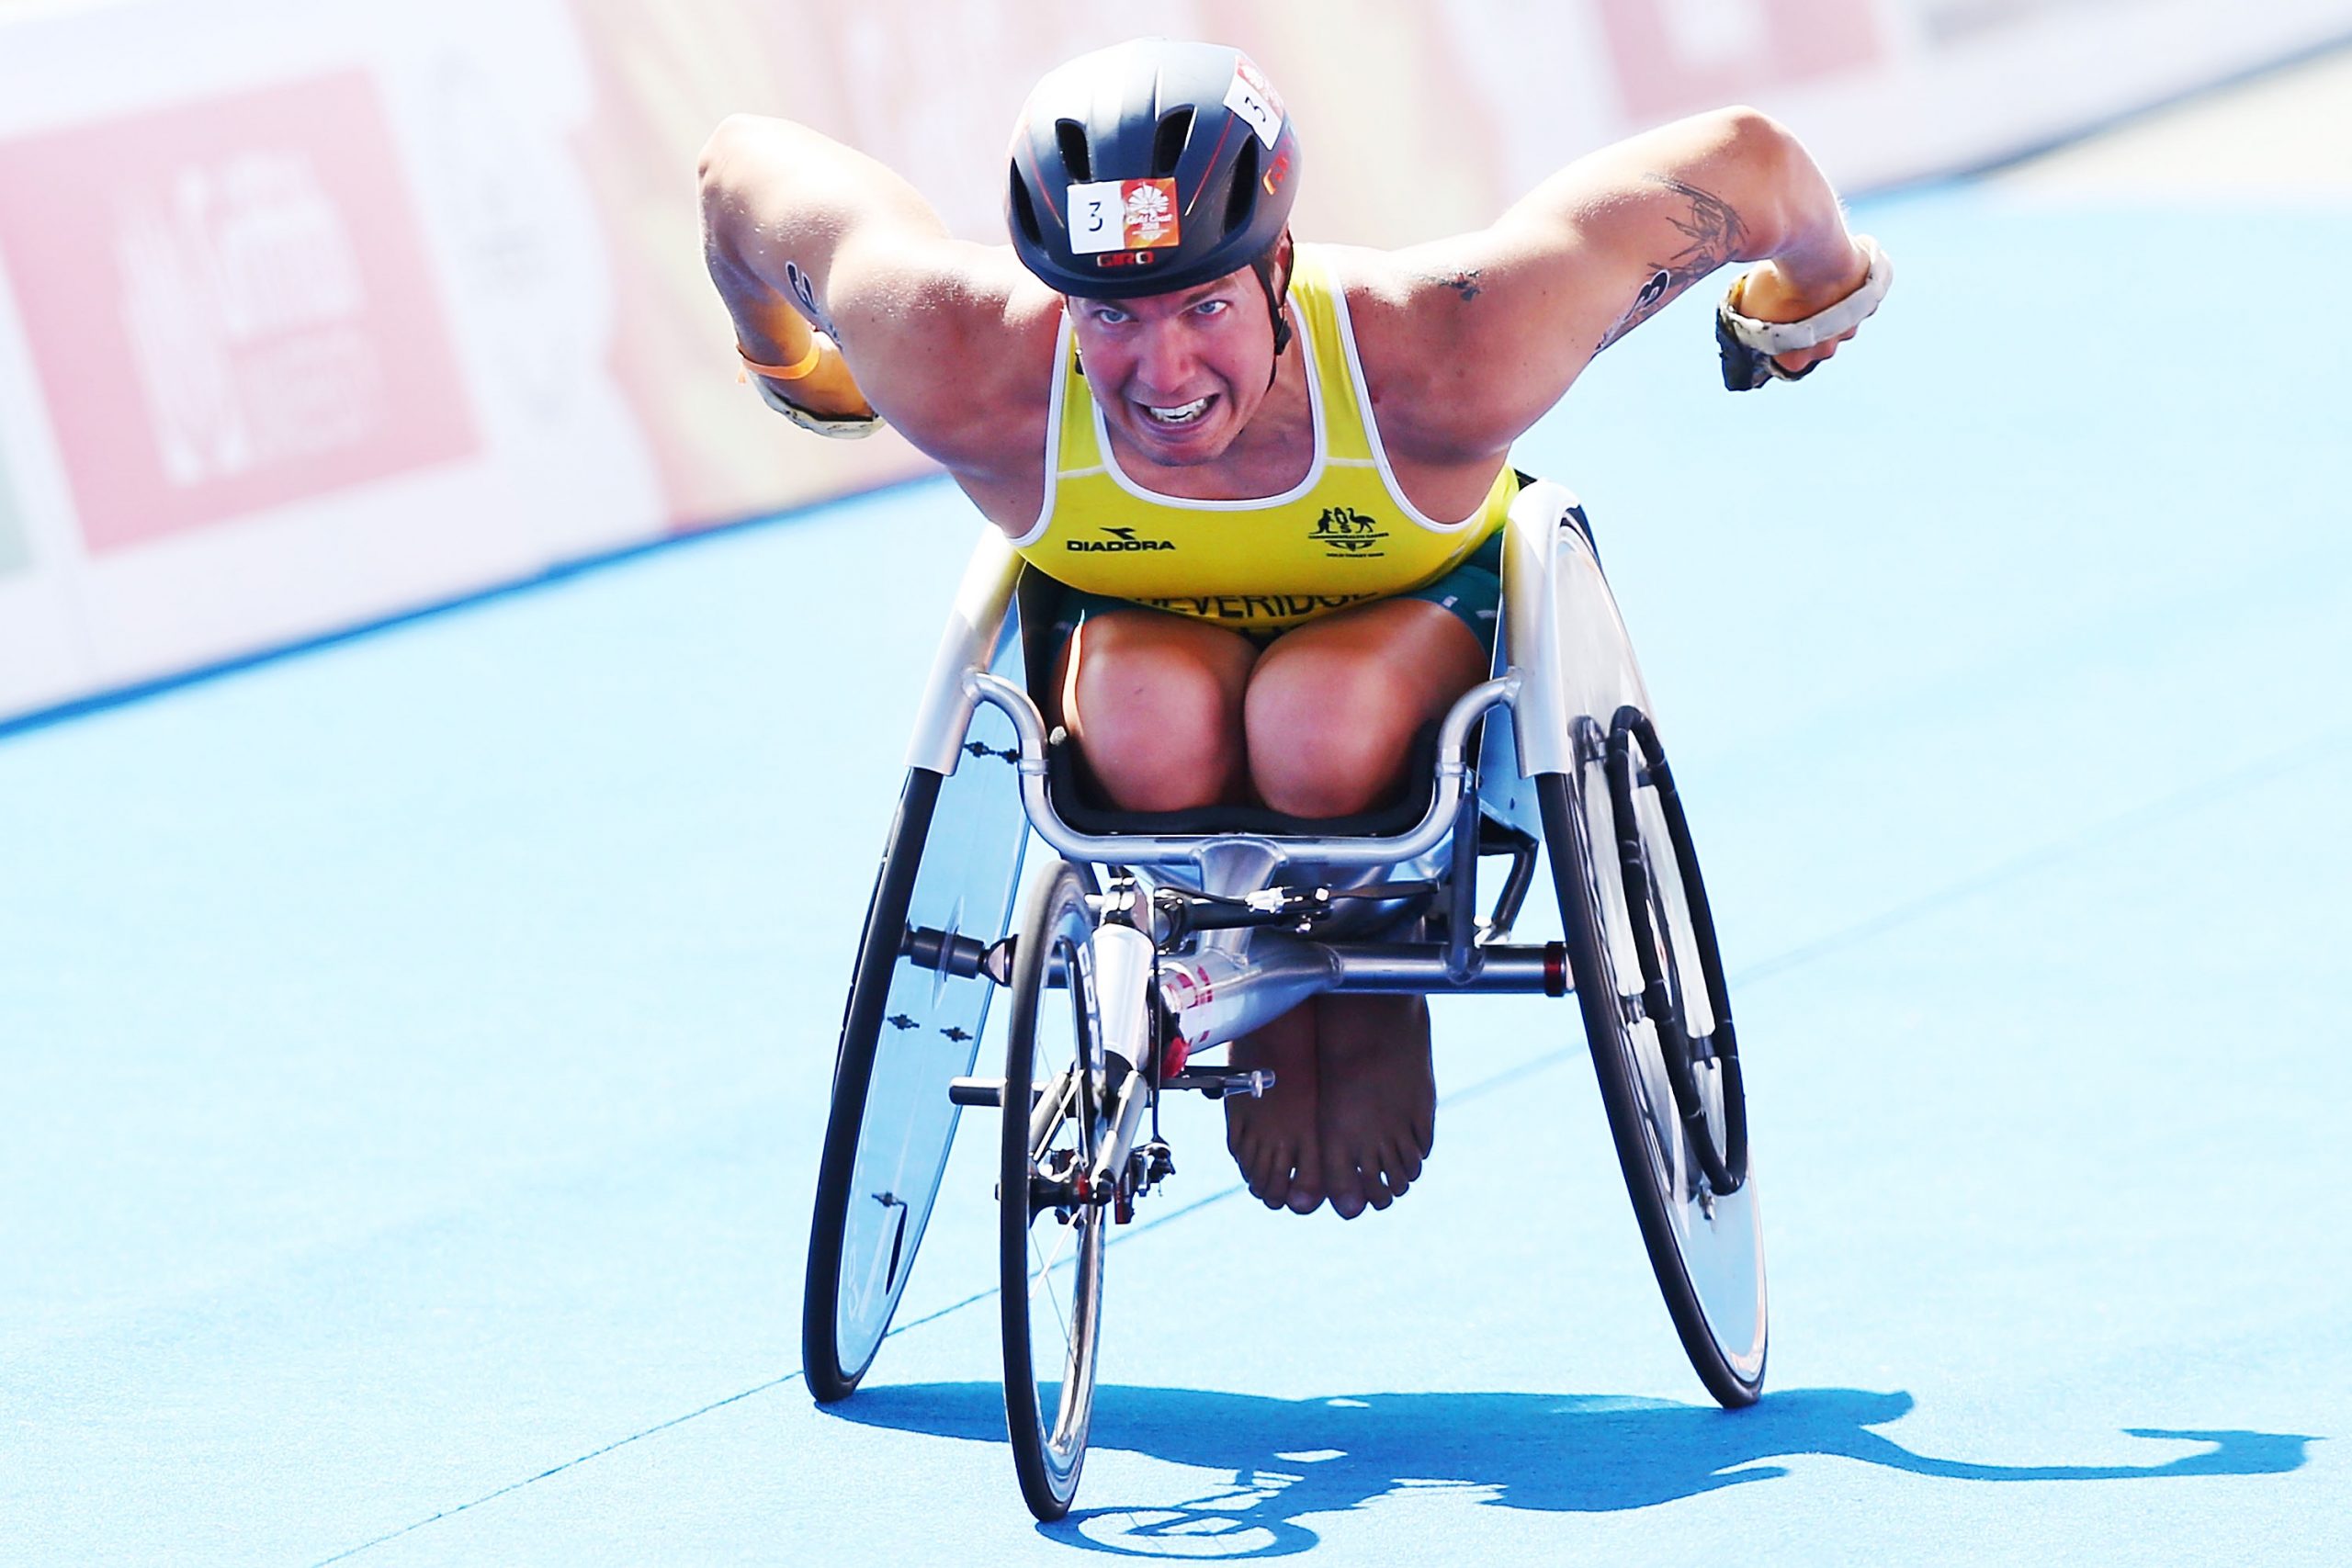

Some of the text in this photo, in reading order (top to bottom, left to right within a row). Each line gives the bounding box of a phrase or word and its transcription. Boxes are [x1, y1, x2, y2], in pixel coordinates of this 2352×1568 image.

[1245, 96, 1267, 123] 3
[1088, 201, 1103, 232] 3
[1096, 251, 1154, 267] GIRO
[1067, 540, 1176, 552] DIADORA
[1136, 592, 1378, 619] EVERID
